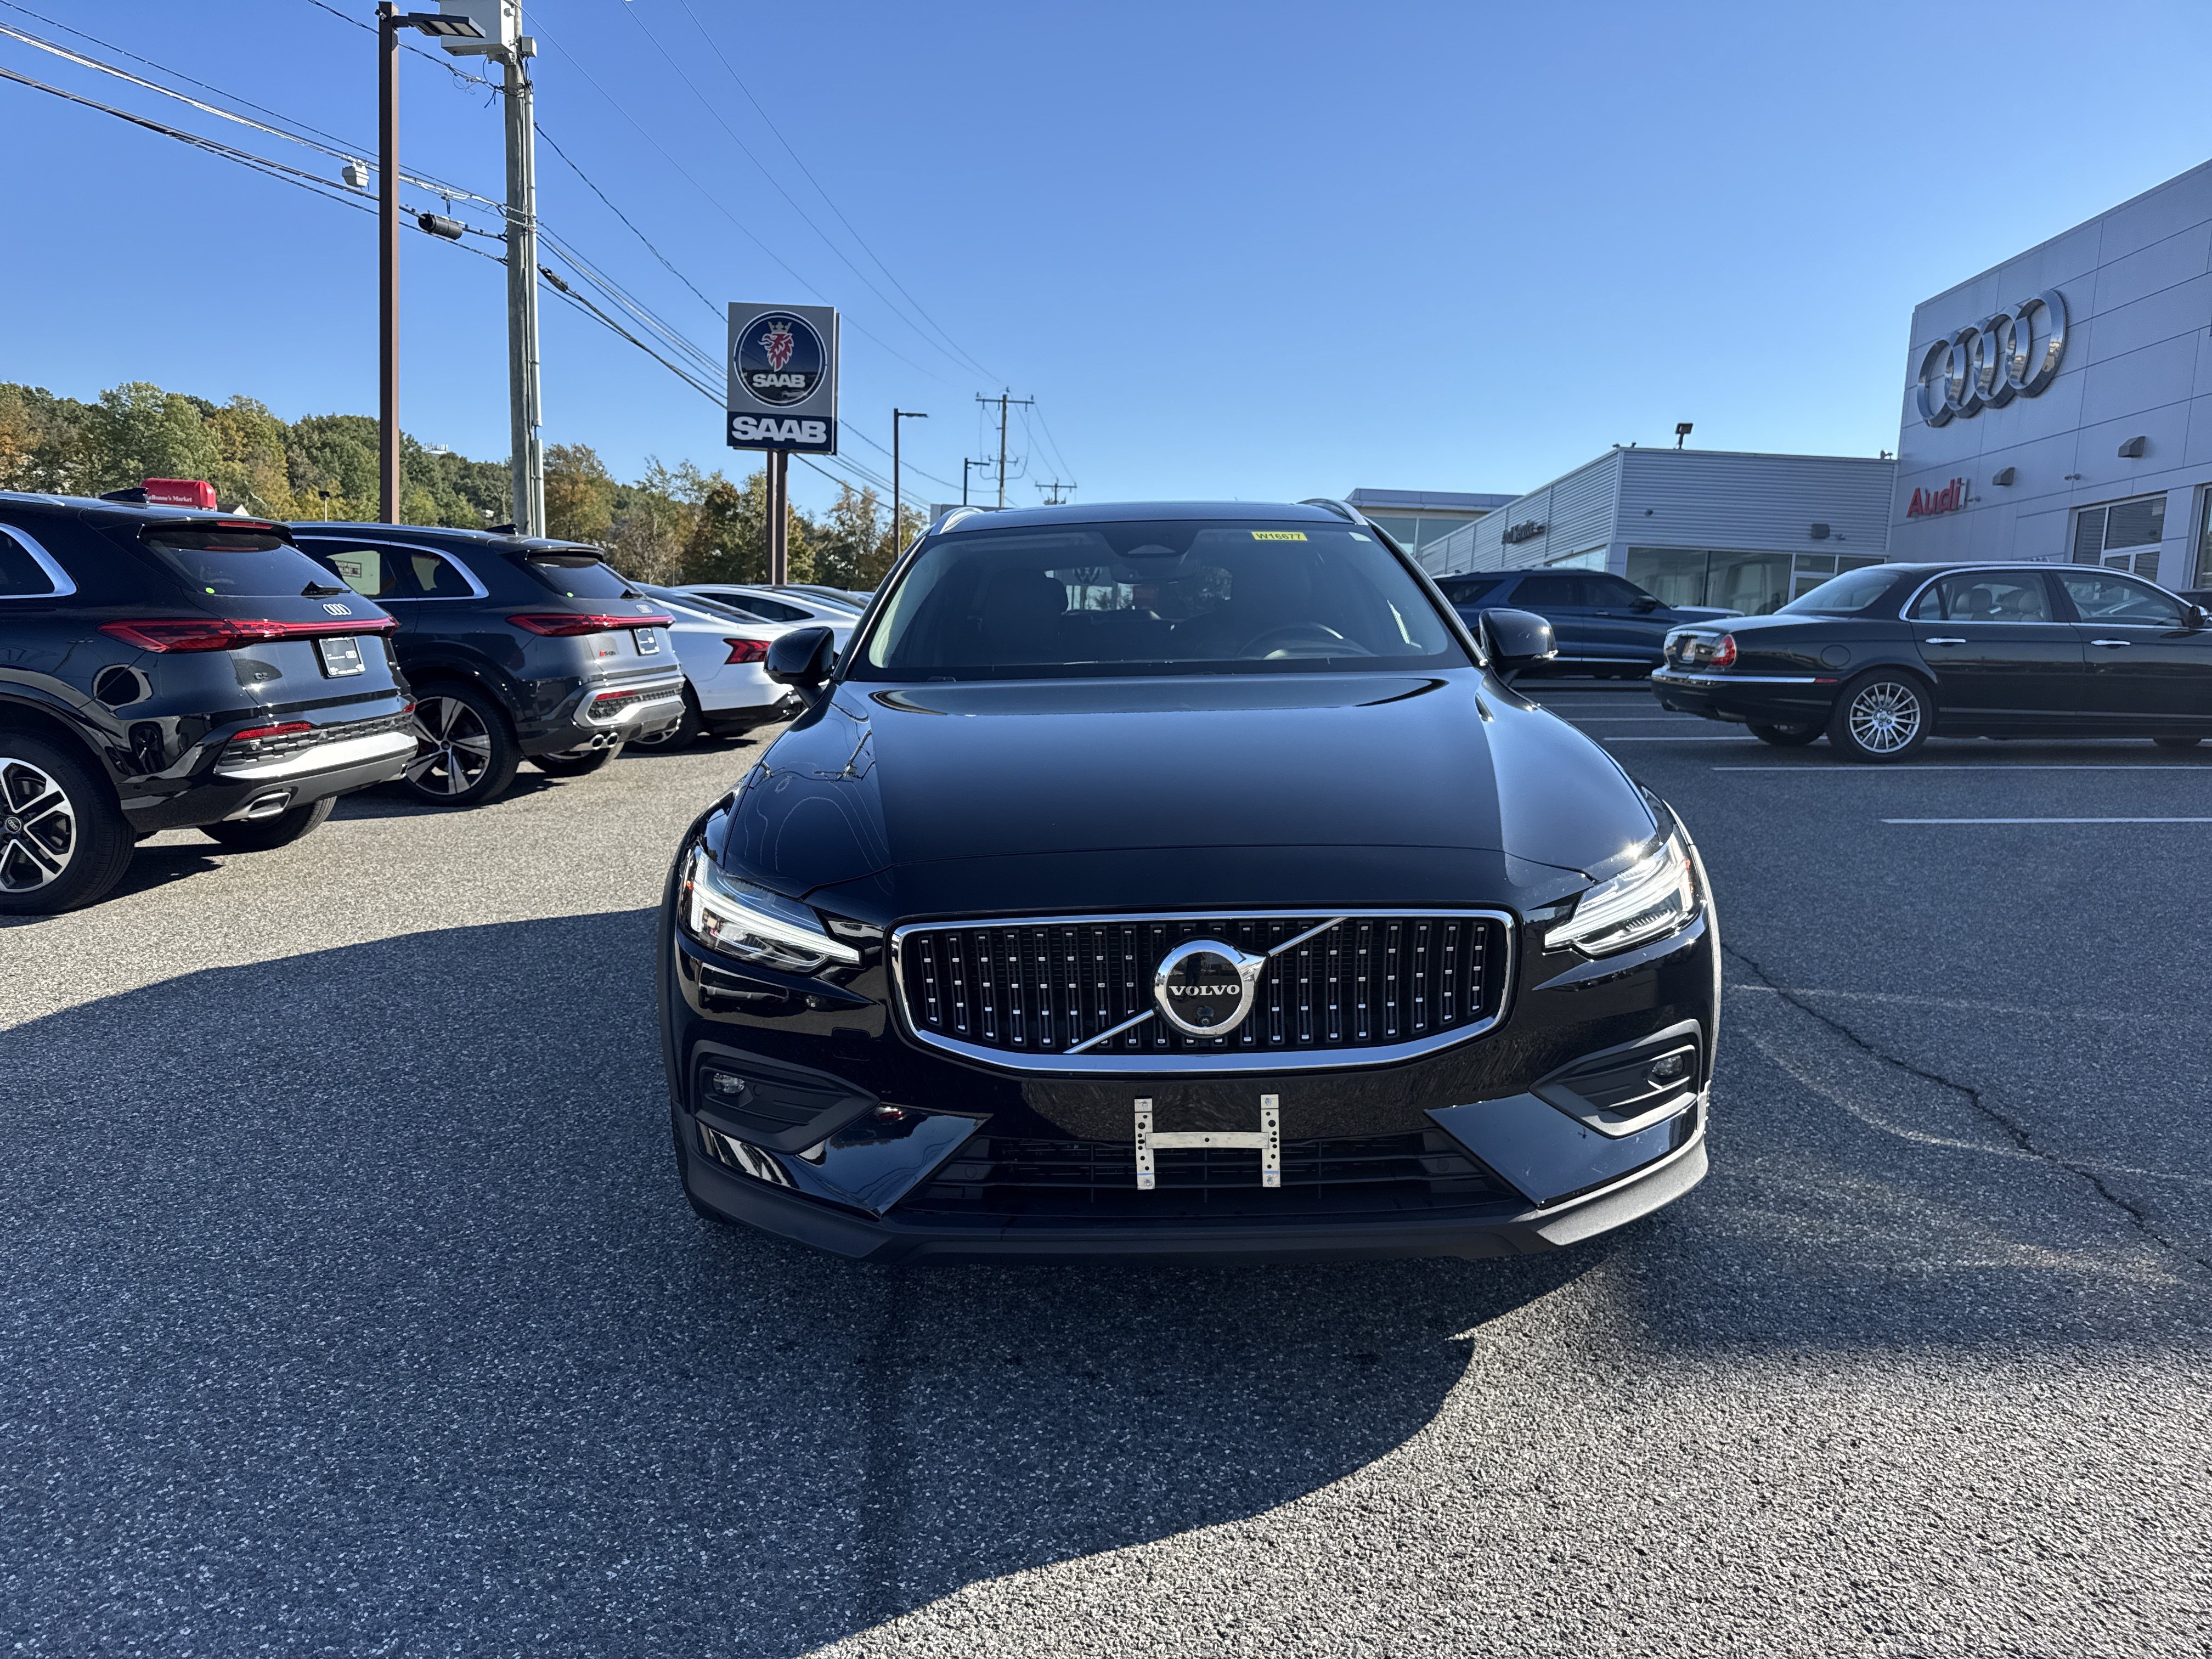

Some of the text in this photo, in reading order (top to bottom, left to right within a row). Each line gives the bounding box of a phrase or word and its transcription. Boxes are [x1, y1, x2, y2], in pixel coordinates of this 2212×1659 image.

[752, 374, 805, 388] SAAB
[731, 416, 827, 444] SAAB
[1906, 477, 1962, 518] Audi
[1169, 984, 1240, 996] VOLVO
